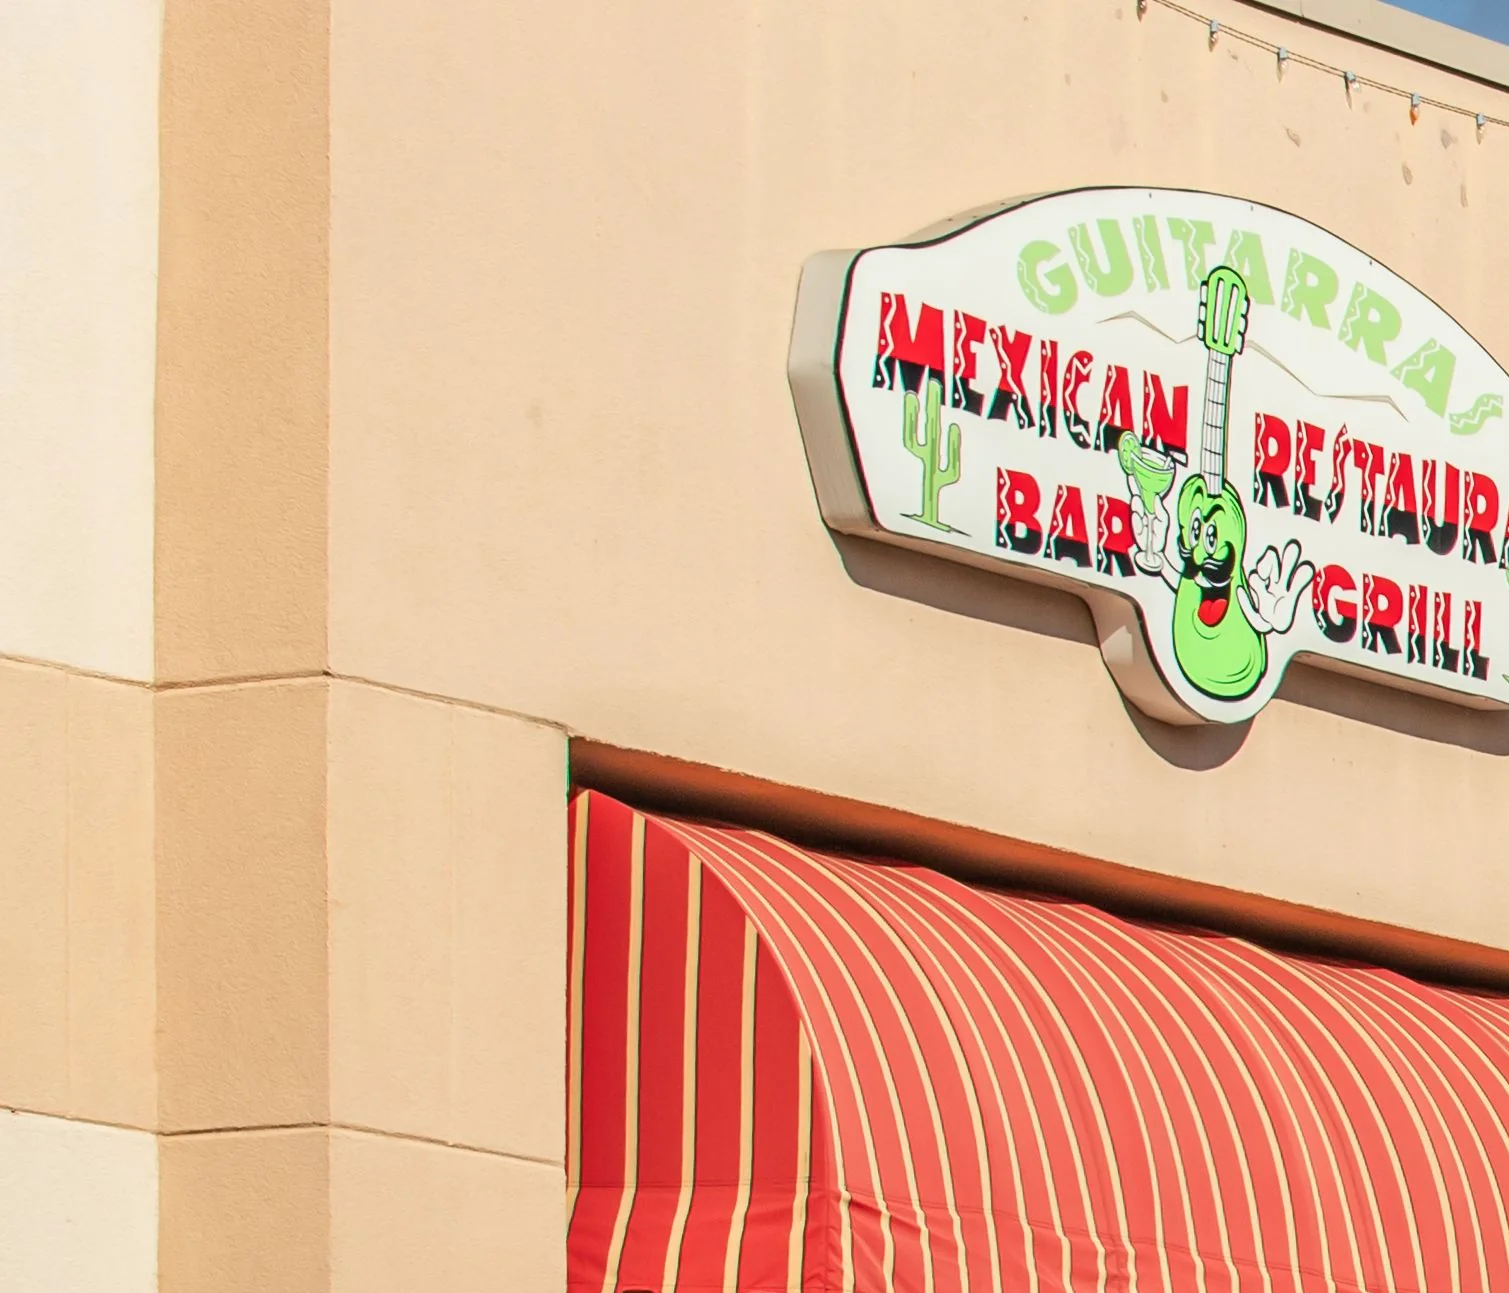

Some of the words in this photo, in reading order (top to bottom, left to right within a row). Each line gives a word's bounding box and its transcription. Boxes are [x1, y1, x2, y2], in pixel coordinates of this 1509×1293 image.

[873, 291, 1189, 462] MEXICAN
[1016, 213, 1505, 436] GUITARRAS
[995, 466, 1138, 577] BAR
[1311, 563, 1489, 682] GRILL
